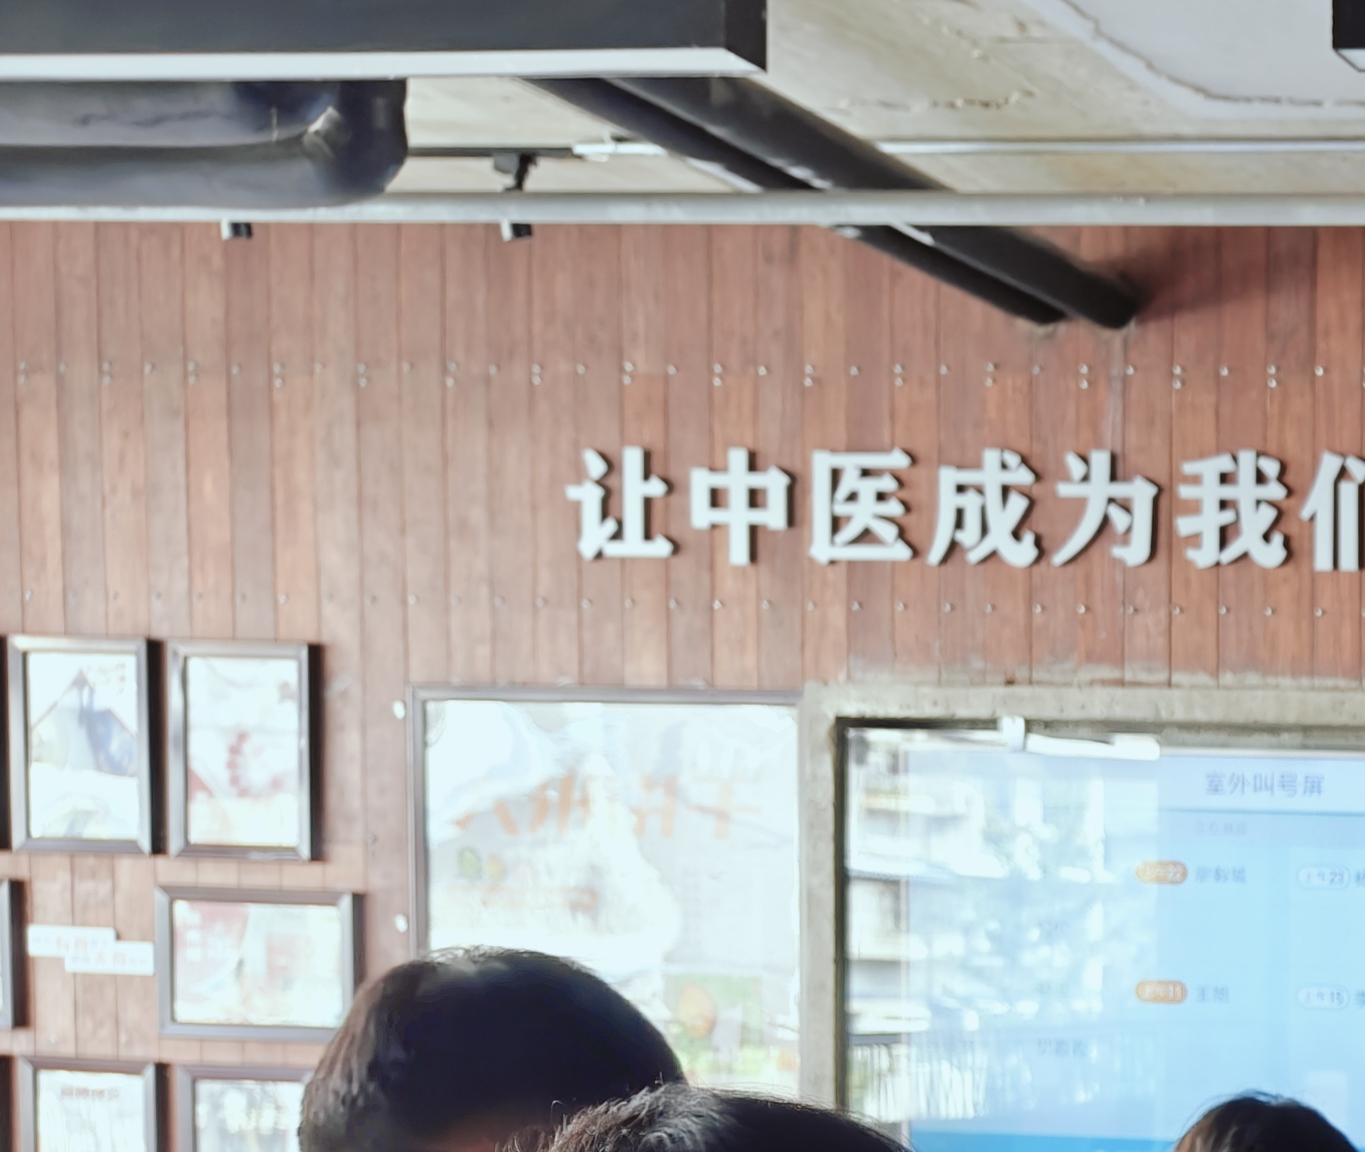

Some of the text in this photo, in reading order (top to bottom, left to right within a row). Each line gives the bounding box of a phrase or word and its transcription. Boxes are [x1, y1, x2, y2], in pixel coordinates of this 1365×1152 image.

[1205, 771, 1326, 798] 室外叫号屏
